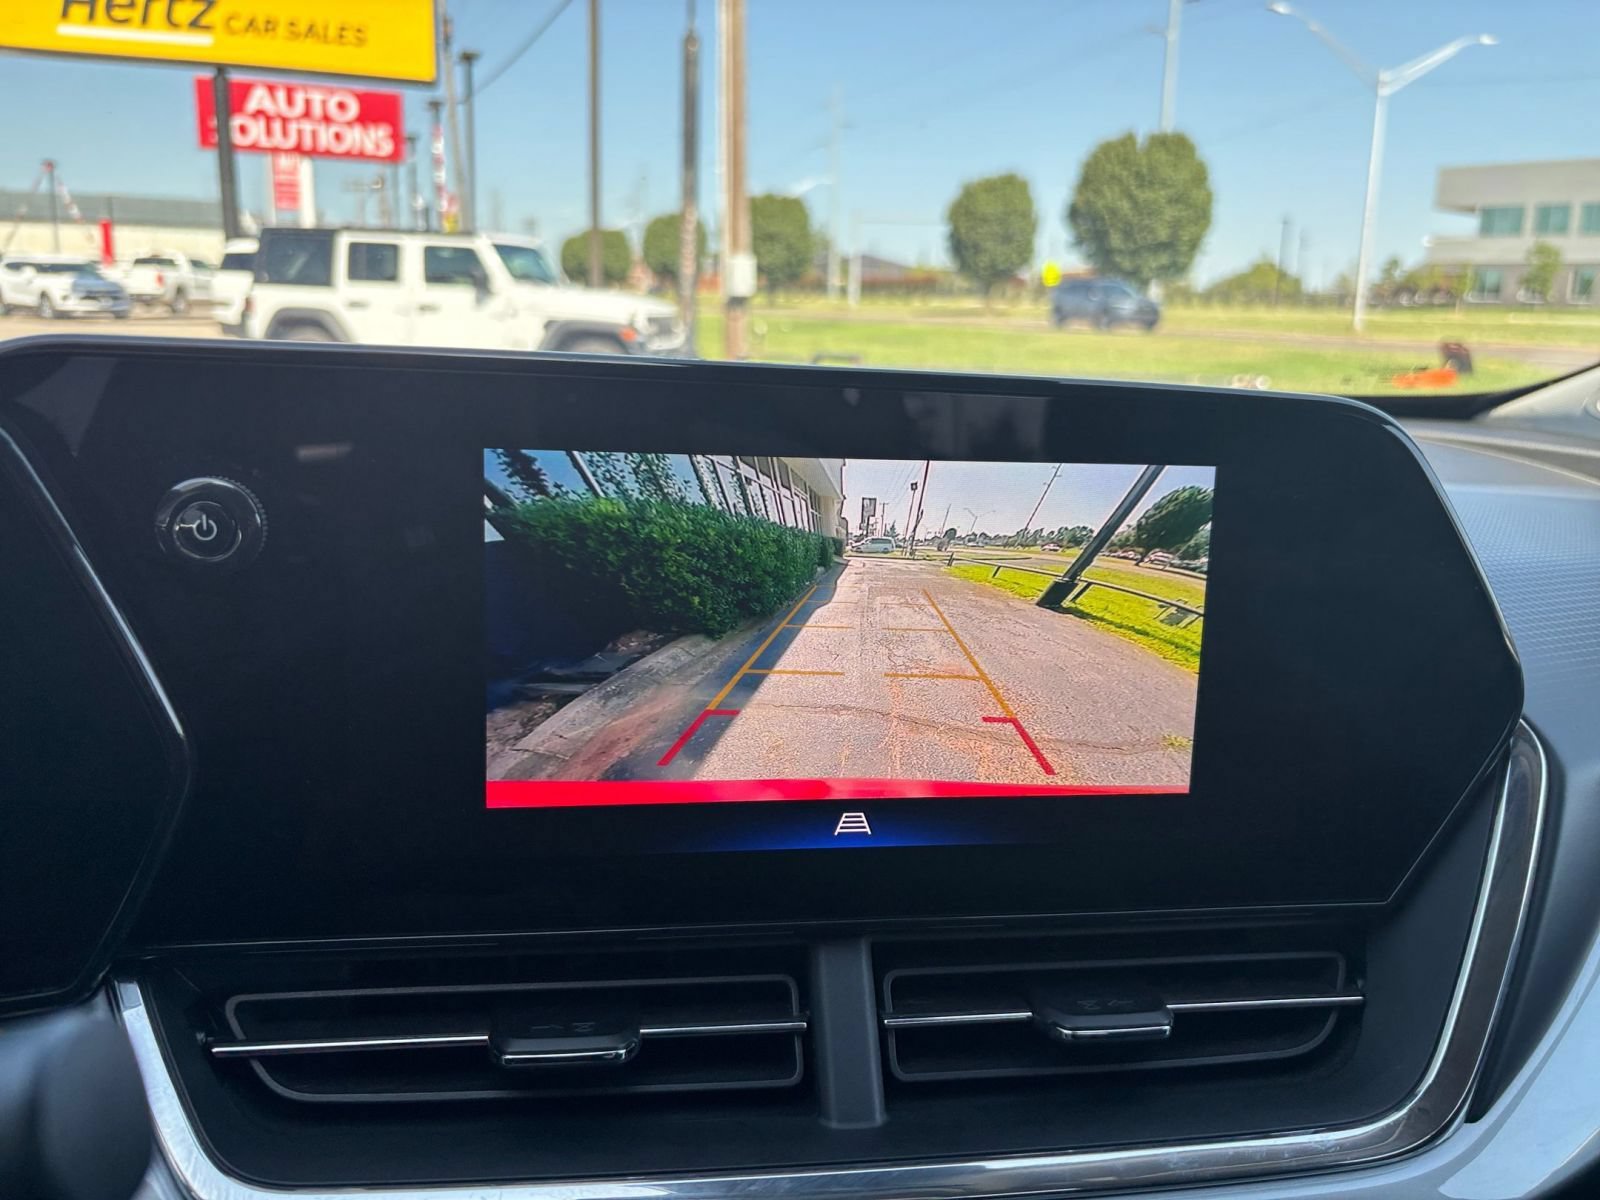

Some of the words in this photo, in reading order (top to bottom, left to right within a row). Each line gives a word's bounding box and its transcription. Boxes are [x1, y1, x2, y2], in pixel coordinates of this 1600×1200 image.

[224, 12, 278, 39] CAR
[286, 19, 369, 48] SALES
[242, 83, 361, 123] AUTO
